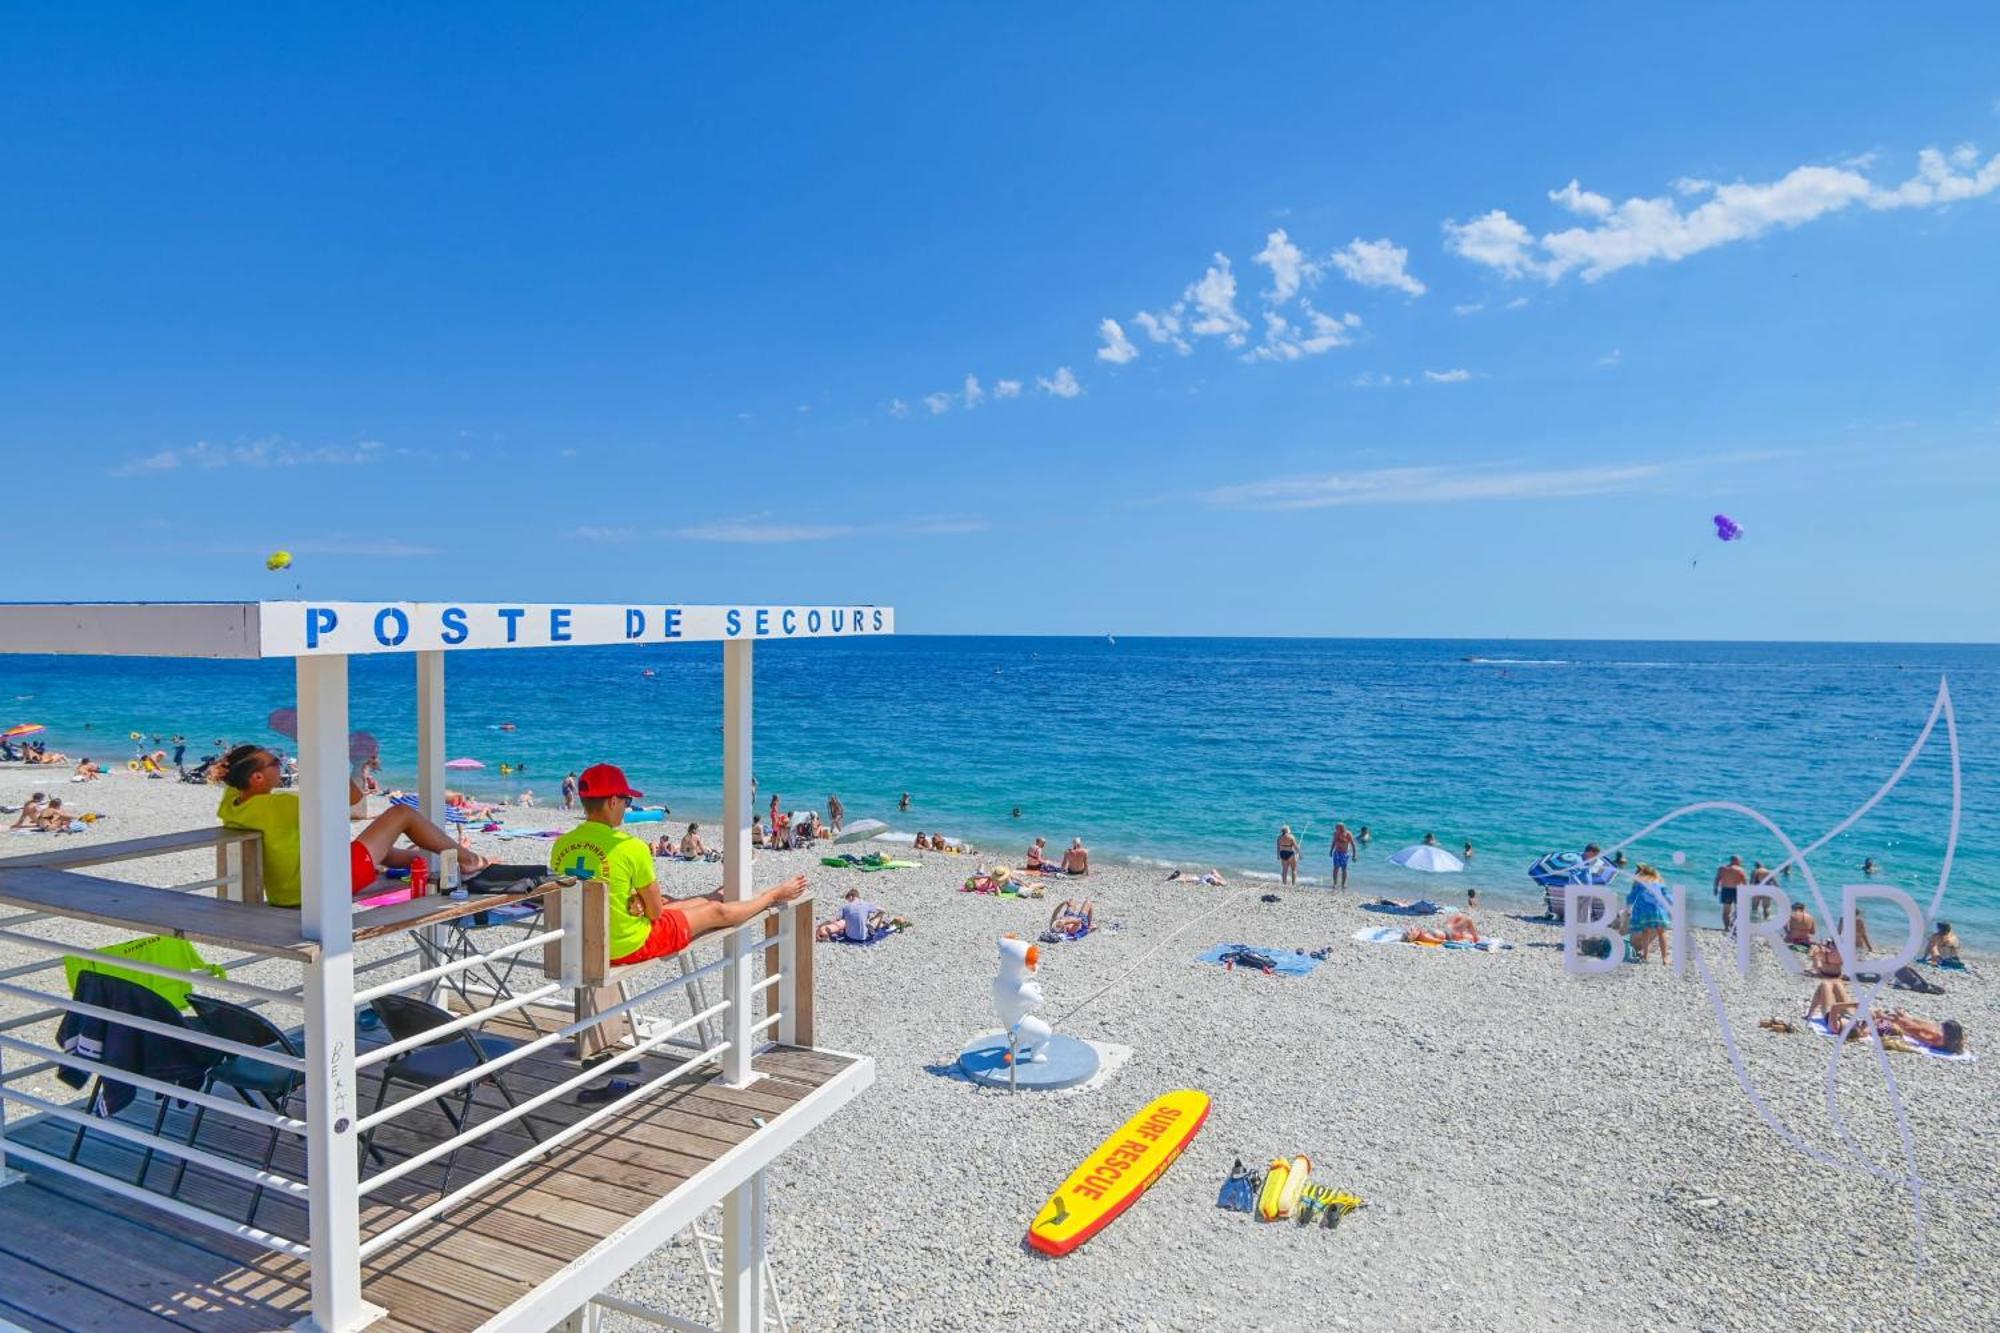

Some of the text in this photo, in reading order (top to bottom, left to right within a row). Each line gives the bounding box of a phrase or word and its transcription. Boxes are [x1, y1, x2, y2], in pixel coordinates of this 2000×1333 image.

[305, 607, 884, 649] POSTE DE SECOURS
[1136, 1107, 1182, 1142] SURF
[1072, 1140, 1149, 1201] RESCUE
